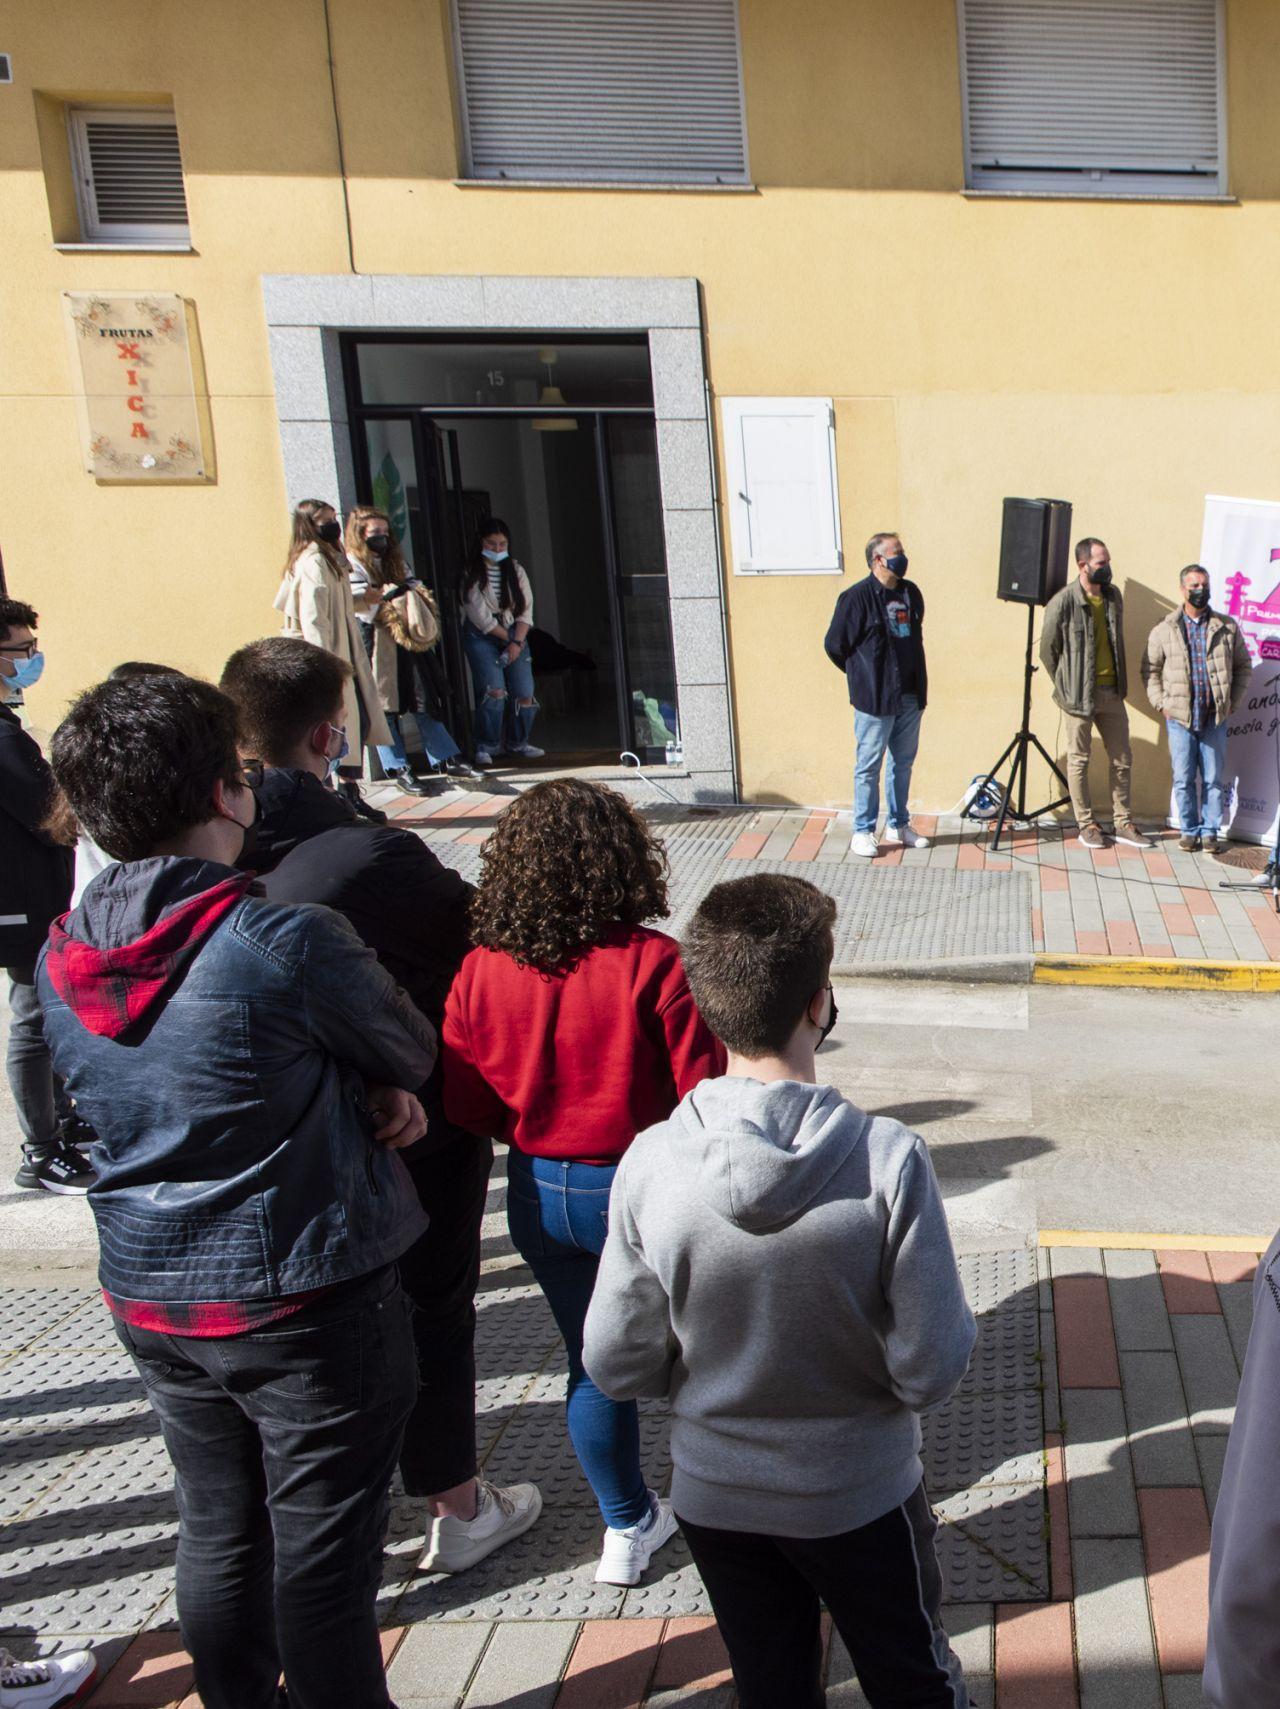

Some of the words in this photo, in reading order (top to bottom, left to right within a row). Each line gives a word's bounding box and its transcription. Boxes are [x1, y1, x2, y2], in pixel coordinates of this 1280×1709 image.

[100, 328, 154, 338] FRUTAS
[487, 370, 505, 387] 15
[116, 342, 150, 439] XICA
